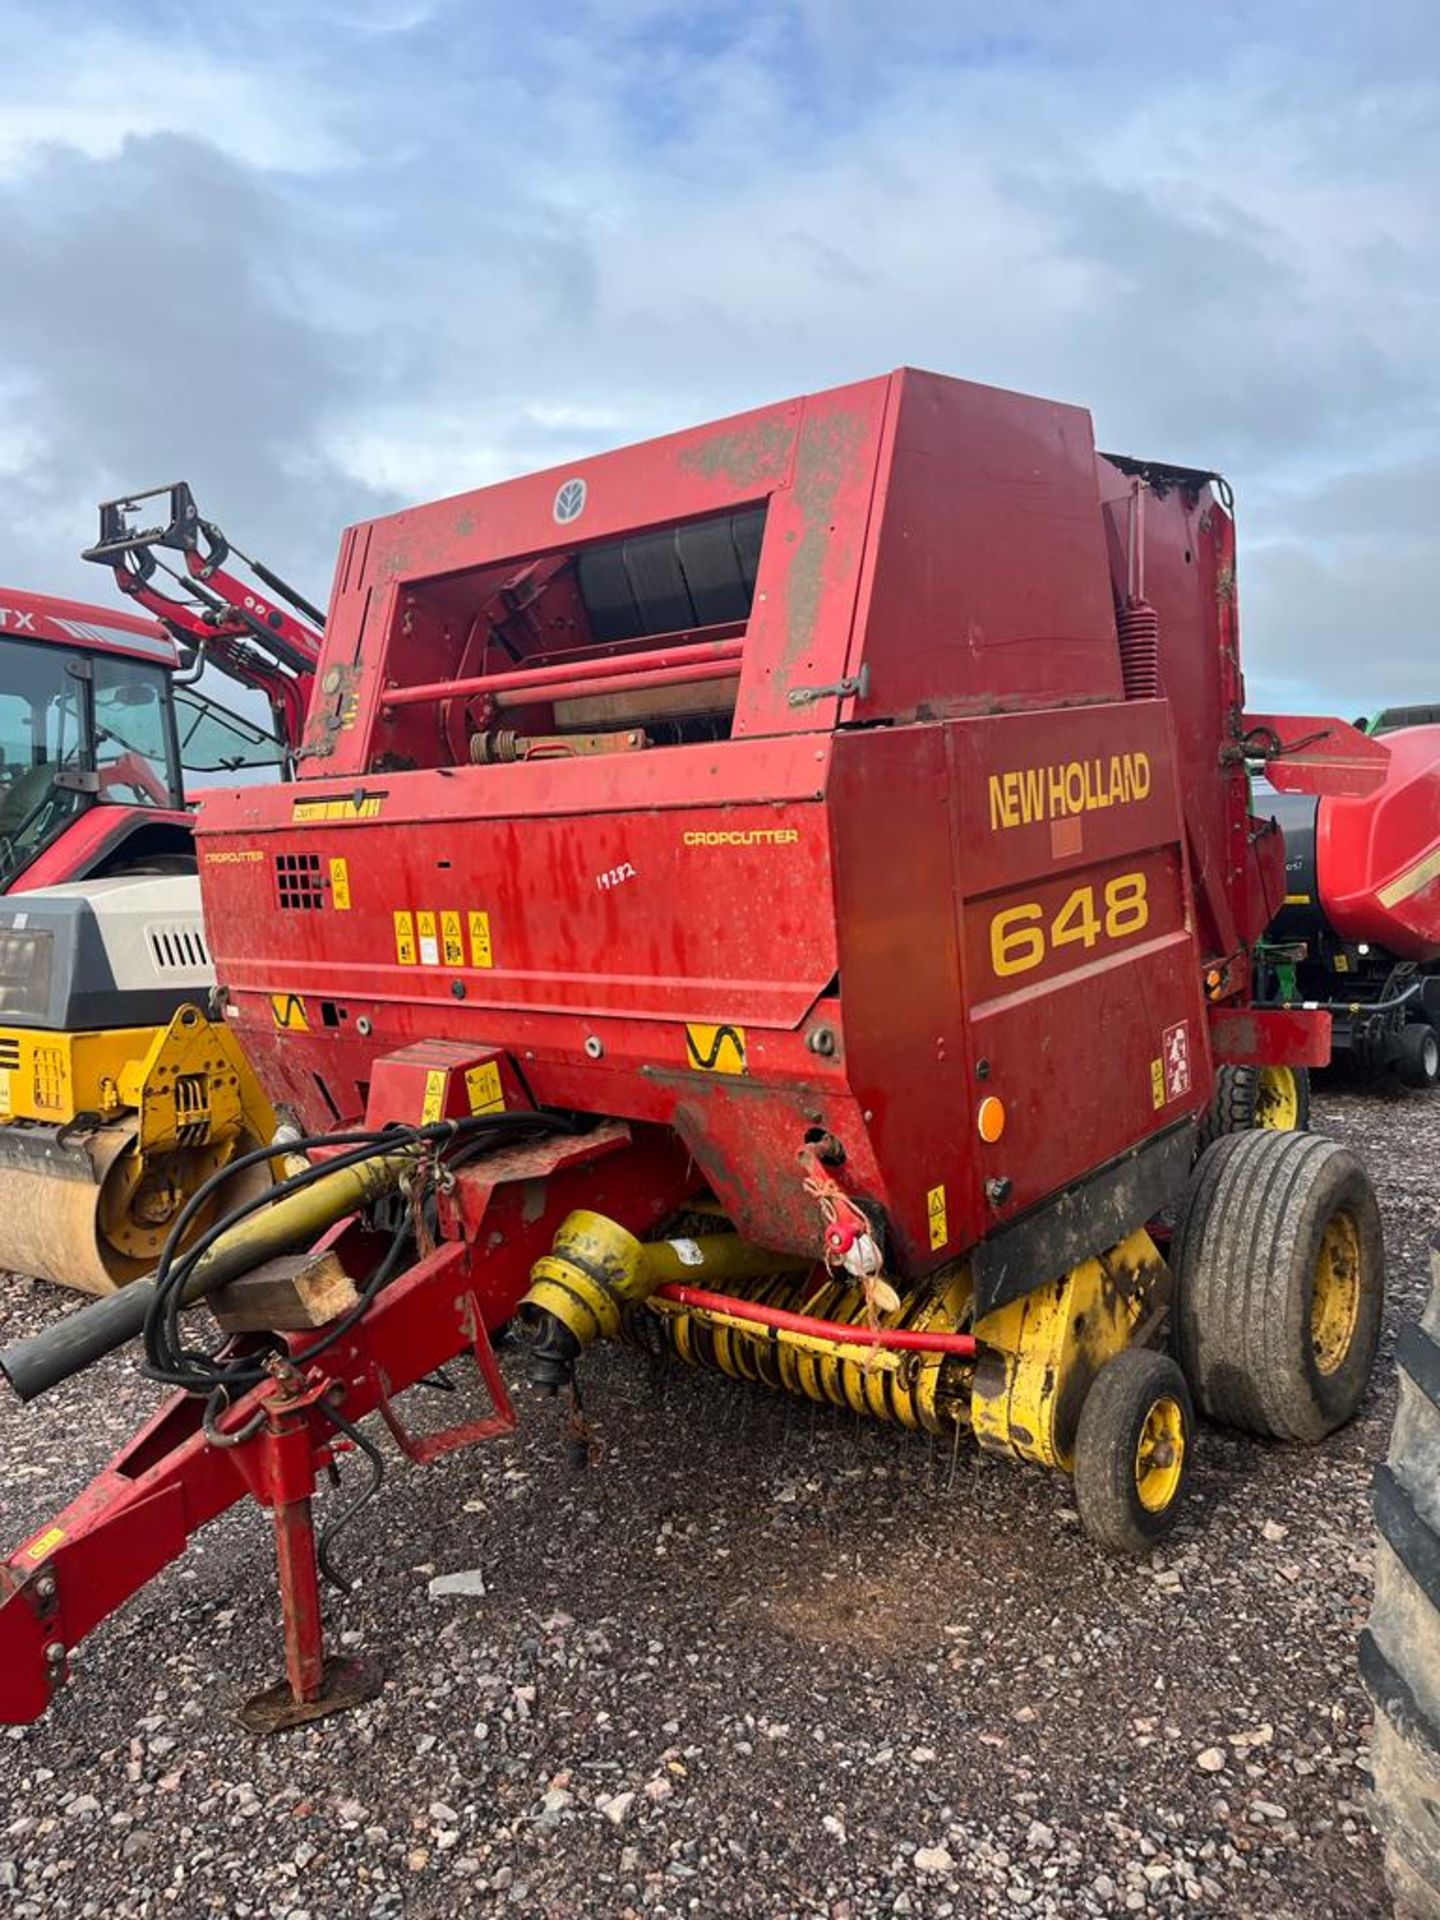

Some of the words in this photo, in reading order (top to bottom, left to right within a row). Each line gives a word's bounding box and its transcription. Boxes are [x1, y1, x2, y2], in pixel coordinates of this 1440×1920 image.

[989, 767, 1045, 831] NEW
[1048, 752, 1150, 818] HOLLAND
[683, 829, 798, 845] CROPCUTTER
[204, 850, 264, 864] CROPCUTTER
[596, 862, 636, 891] 19282
[990, 872, 1149, 977] 648
